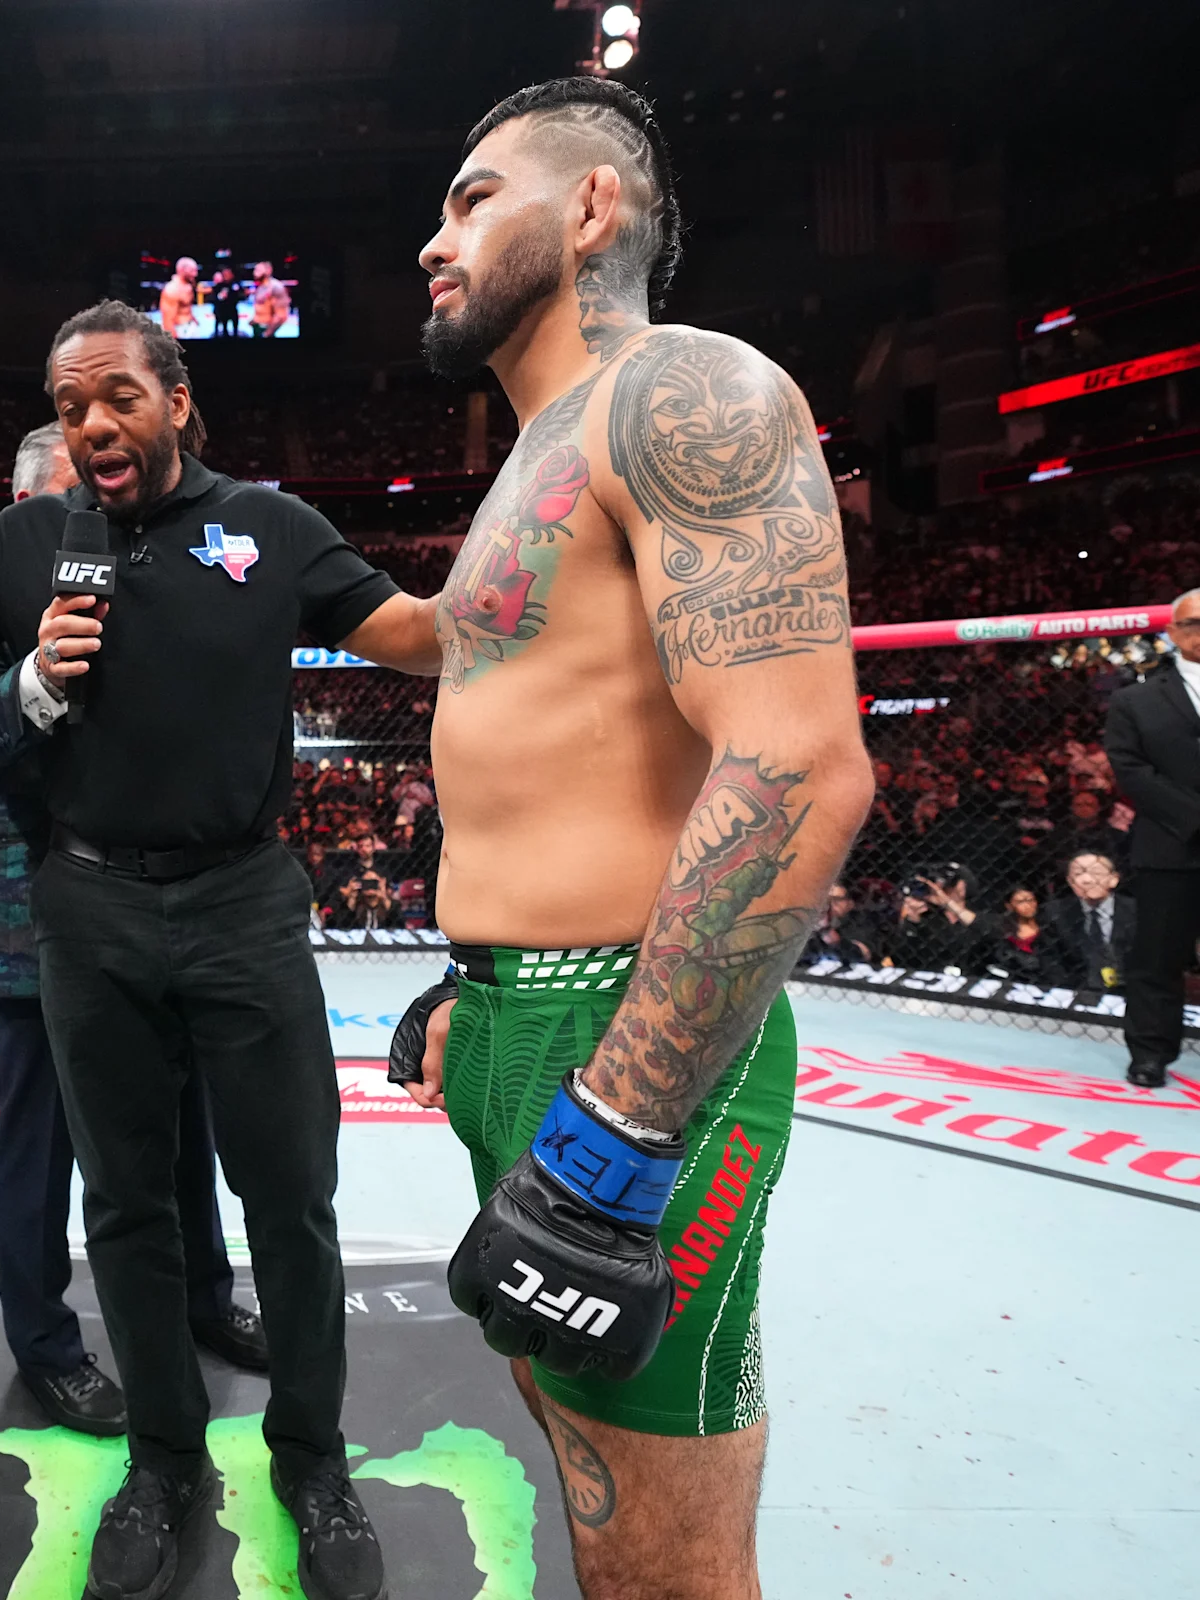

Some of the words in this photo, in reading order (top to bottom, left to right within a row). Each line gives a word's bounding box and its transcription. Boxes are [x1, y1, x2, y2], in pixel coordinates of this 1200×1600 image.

[1082, 363, 1137, 391] UFC
[57, 561, 112, 585] UFC
[1037, 618, 1085, 635] AUTO
[1087, 613, 1150, 631] PARTS
[497, 1259, 621, 1338] UFC
